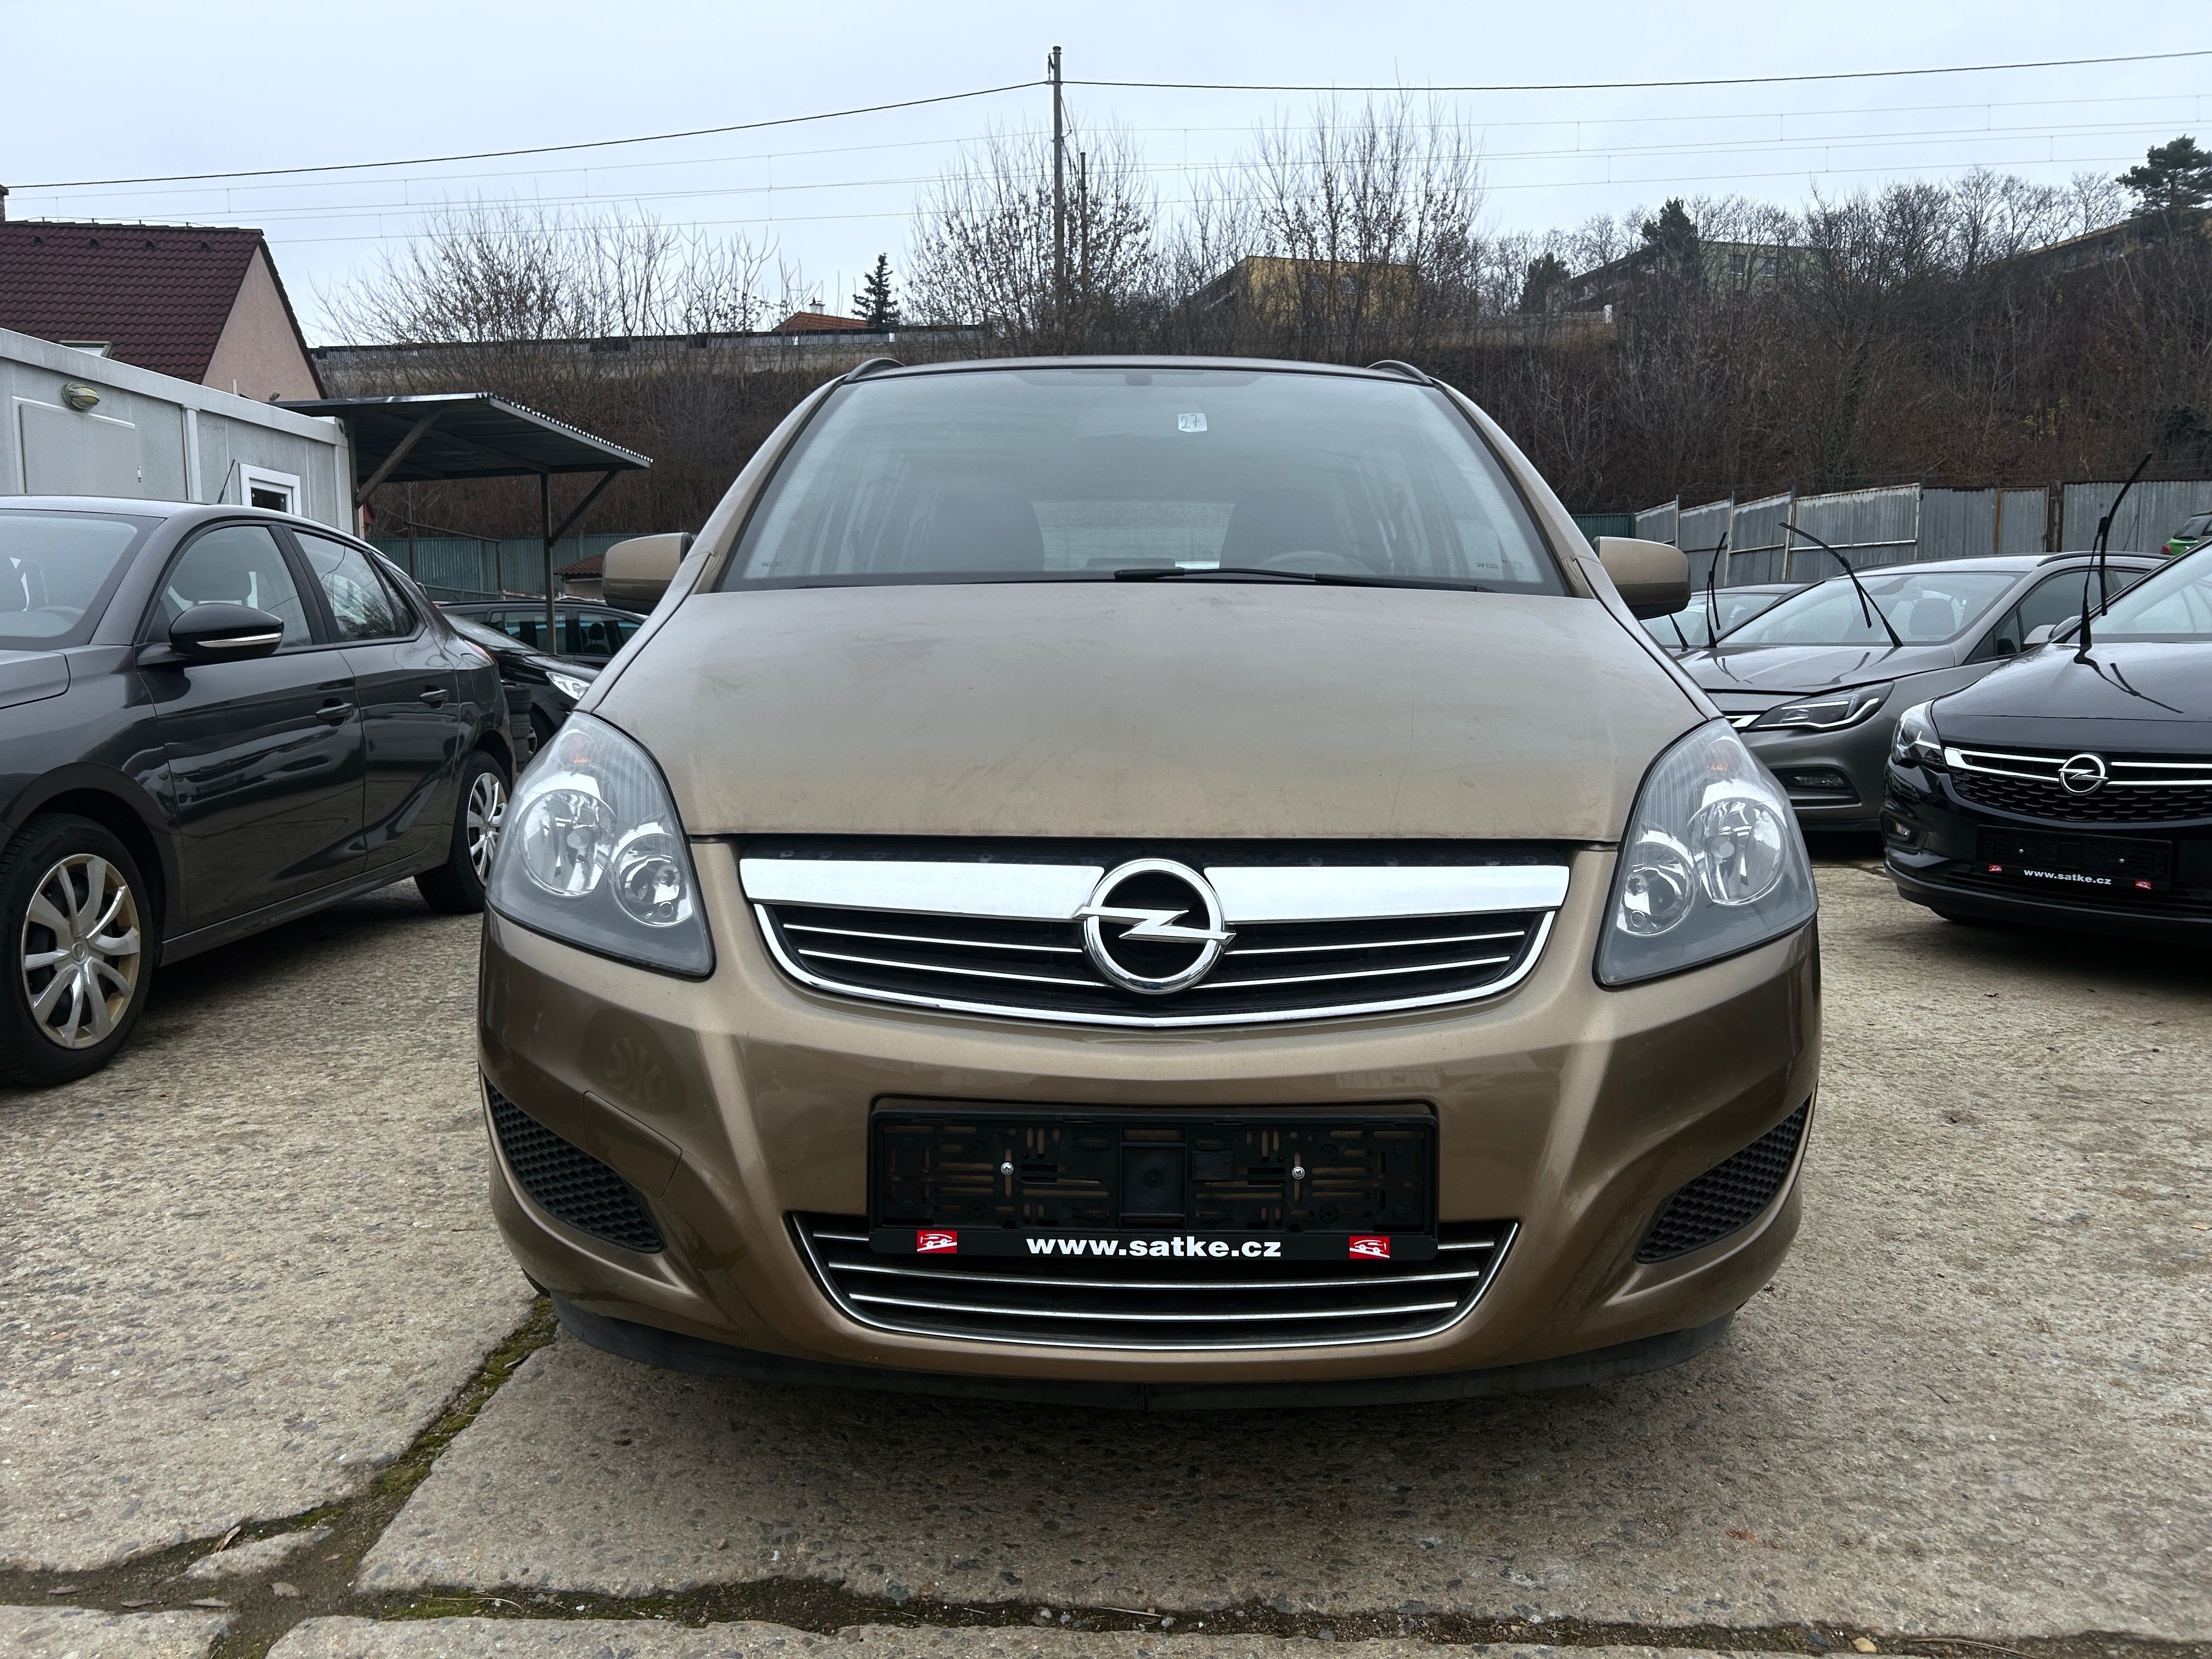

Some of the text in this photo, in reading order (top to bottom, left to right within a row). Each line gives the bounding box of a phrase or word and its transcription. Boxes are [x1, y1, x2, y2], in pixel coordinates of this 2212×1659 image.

[1181, 414, 1200, 429] 27
[2023, 869, 2112, 885] www.satke.cz
[1026, 1235, 1281, 1257] www.satke.cz
